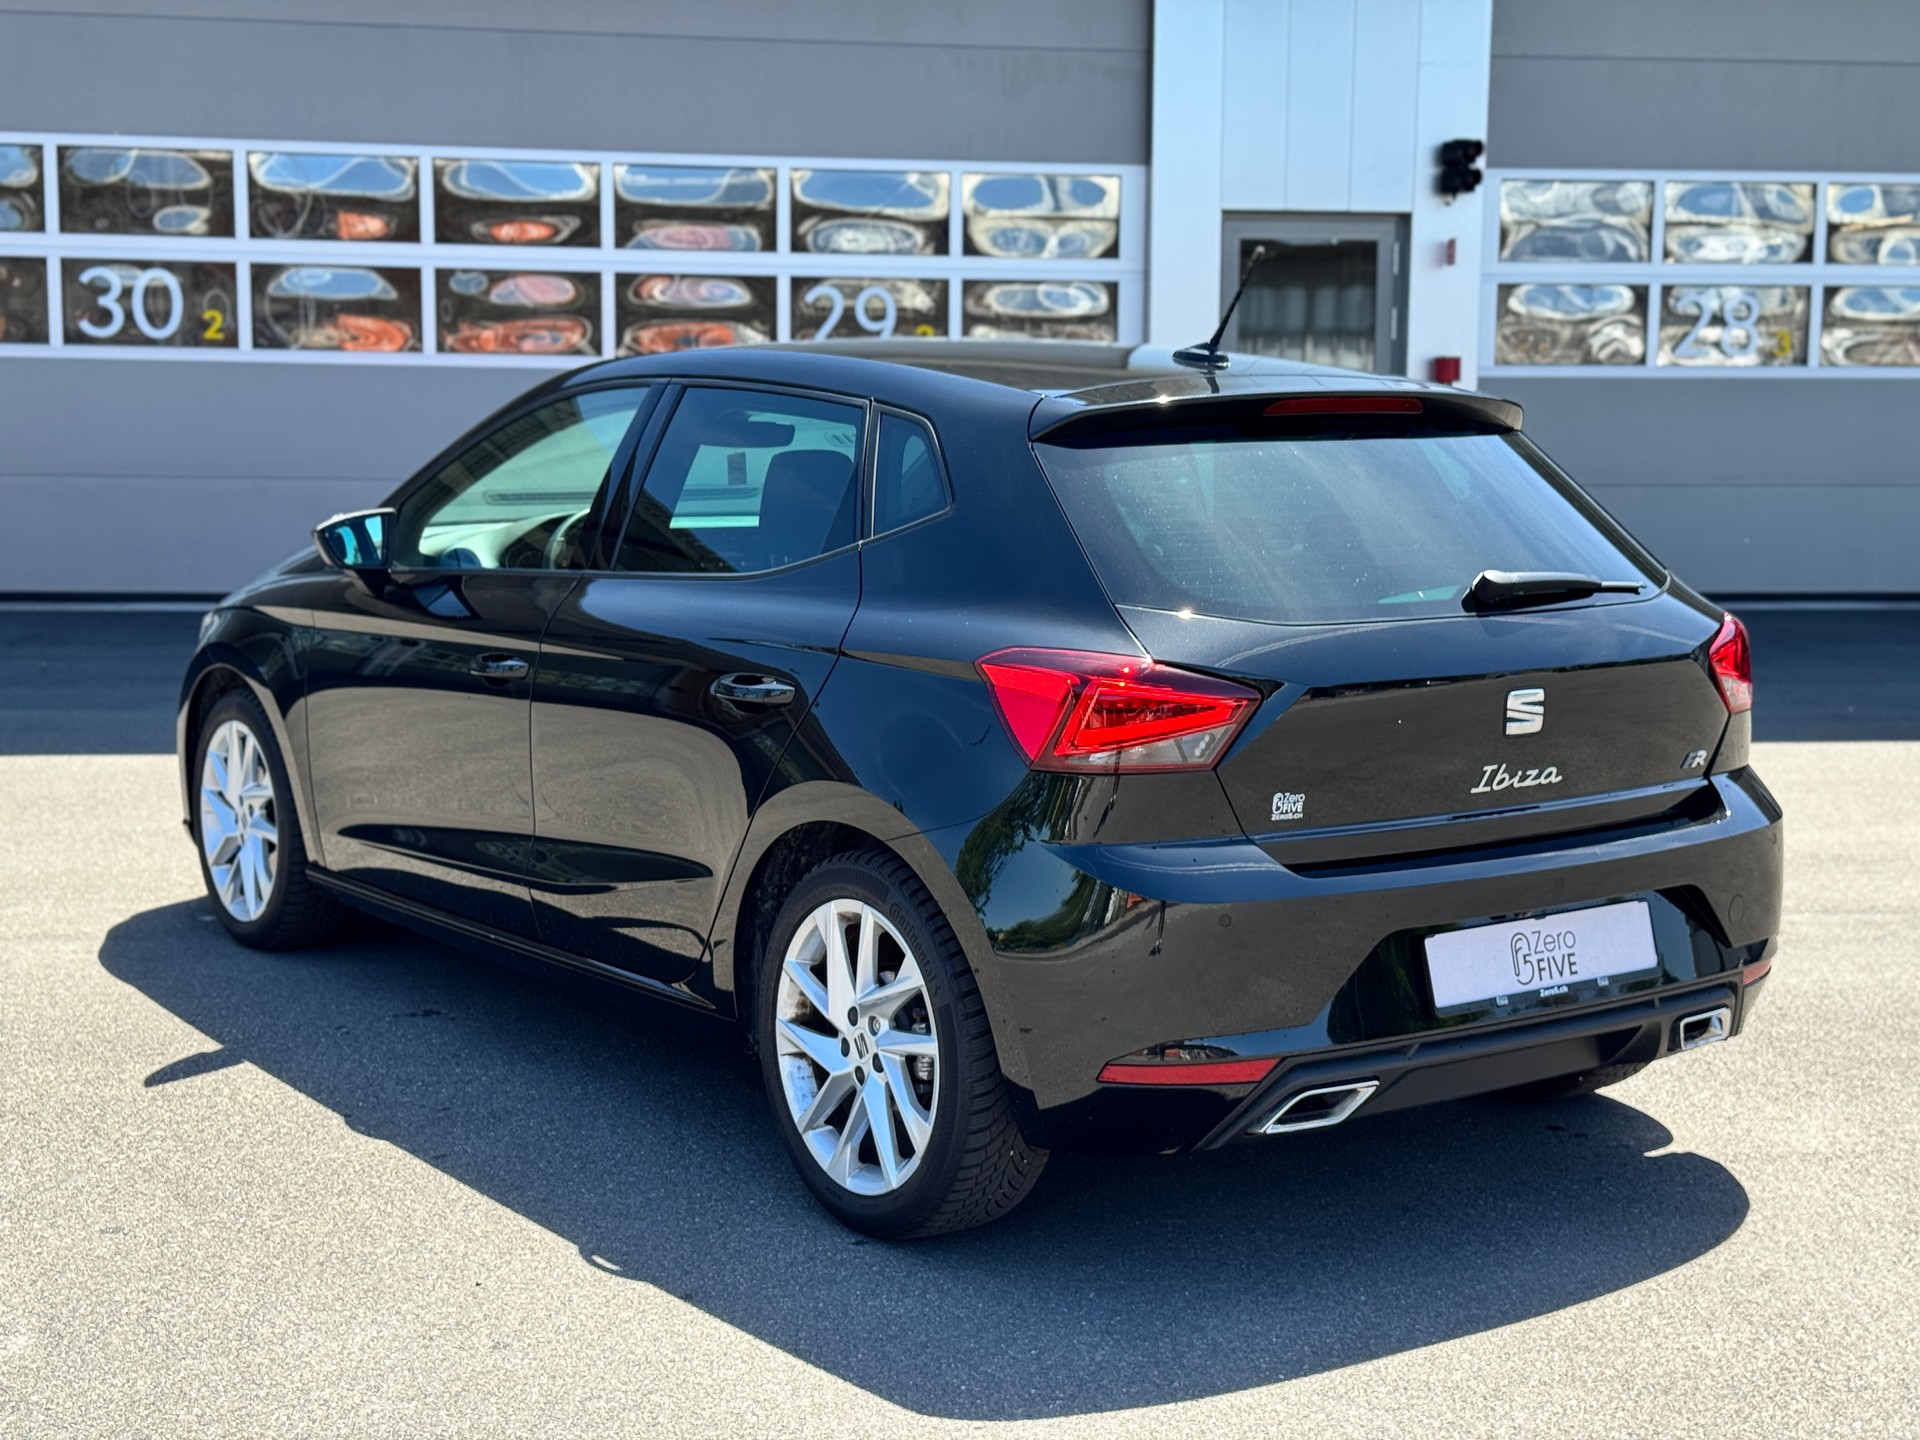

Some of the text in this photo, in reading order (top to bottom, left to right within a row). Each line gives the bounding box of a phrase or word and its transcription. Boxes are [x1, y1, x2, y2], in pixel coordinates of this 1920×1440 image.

[78, 265, 184, 340] 30
[804, 285, 897, 341] 29
[202, 309, 225, 340] 2
[1673, 290, 1761, 357] 28
[1773, 330, 1792, 357] 3
[1681, 749, 1708, 769] FR
[1470, 763, 1563, 794] Ibiza
[1282, 801, 1304, 813] FIVE
[1284, 792, 1306, 803] Zero
[889, 903, 938, 984] Continental
[1531, 930, 1577, 955] Zero
[1536, 952, 1579, 982] FIVE
